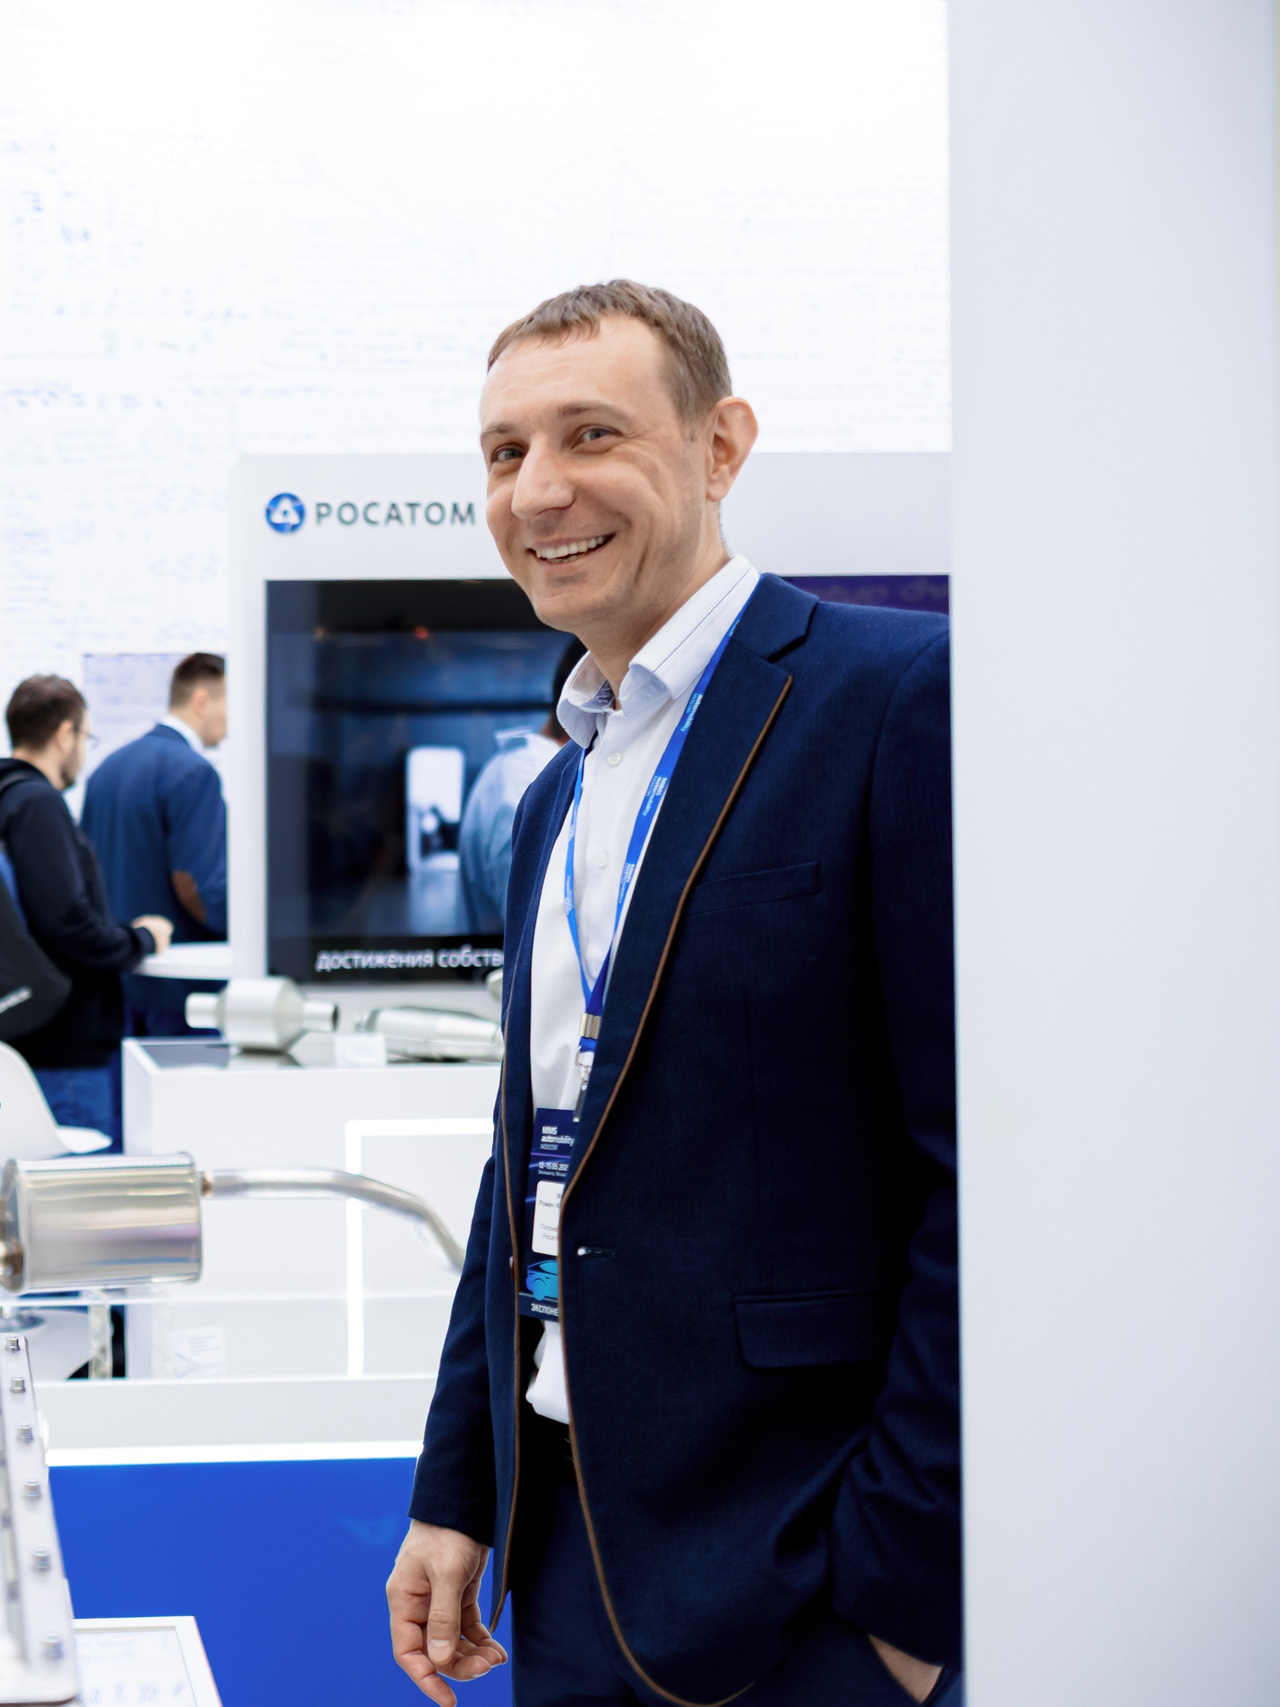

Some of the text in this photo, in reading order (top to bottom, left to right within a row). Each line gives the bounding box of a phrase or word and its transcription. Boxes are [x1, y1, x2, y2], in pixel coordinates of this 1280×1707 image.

[315, 502, 476, 526] РОСАТОМ
[315, 950, 434, 972] достижения
[542, 1126, 558, 1135] MIMS
[540, 1135, 575, 1147] automobility
[531, 1303, 559, 1317] ЭКСПОНЕ
